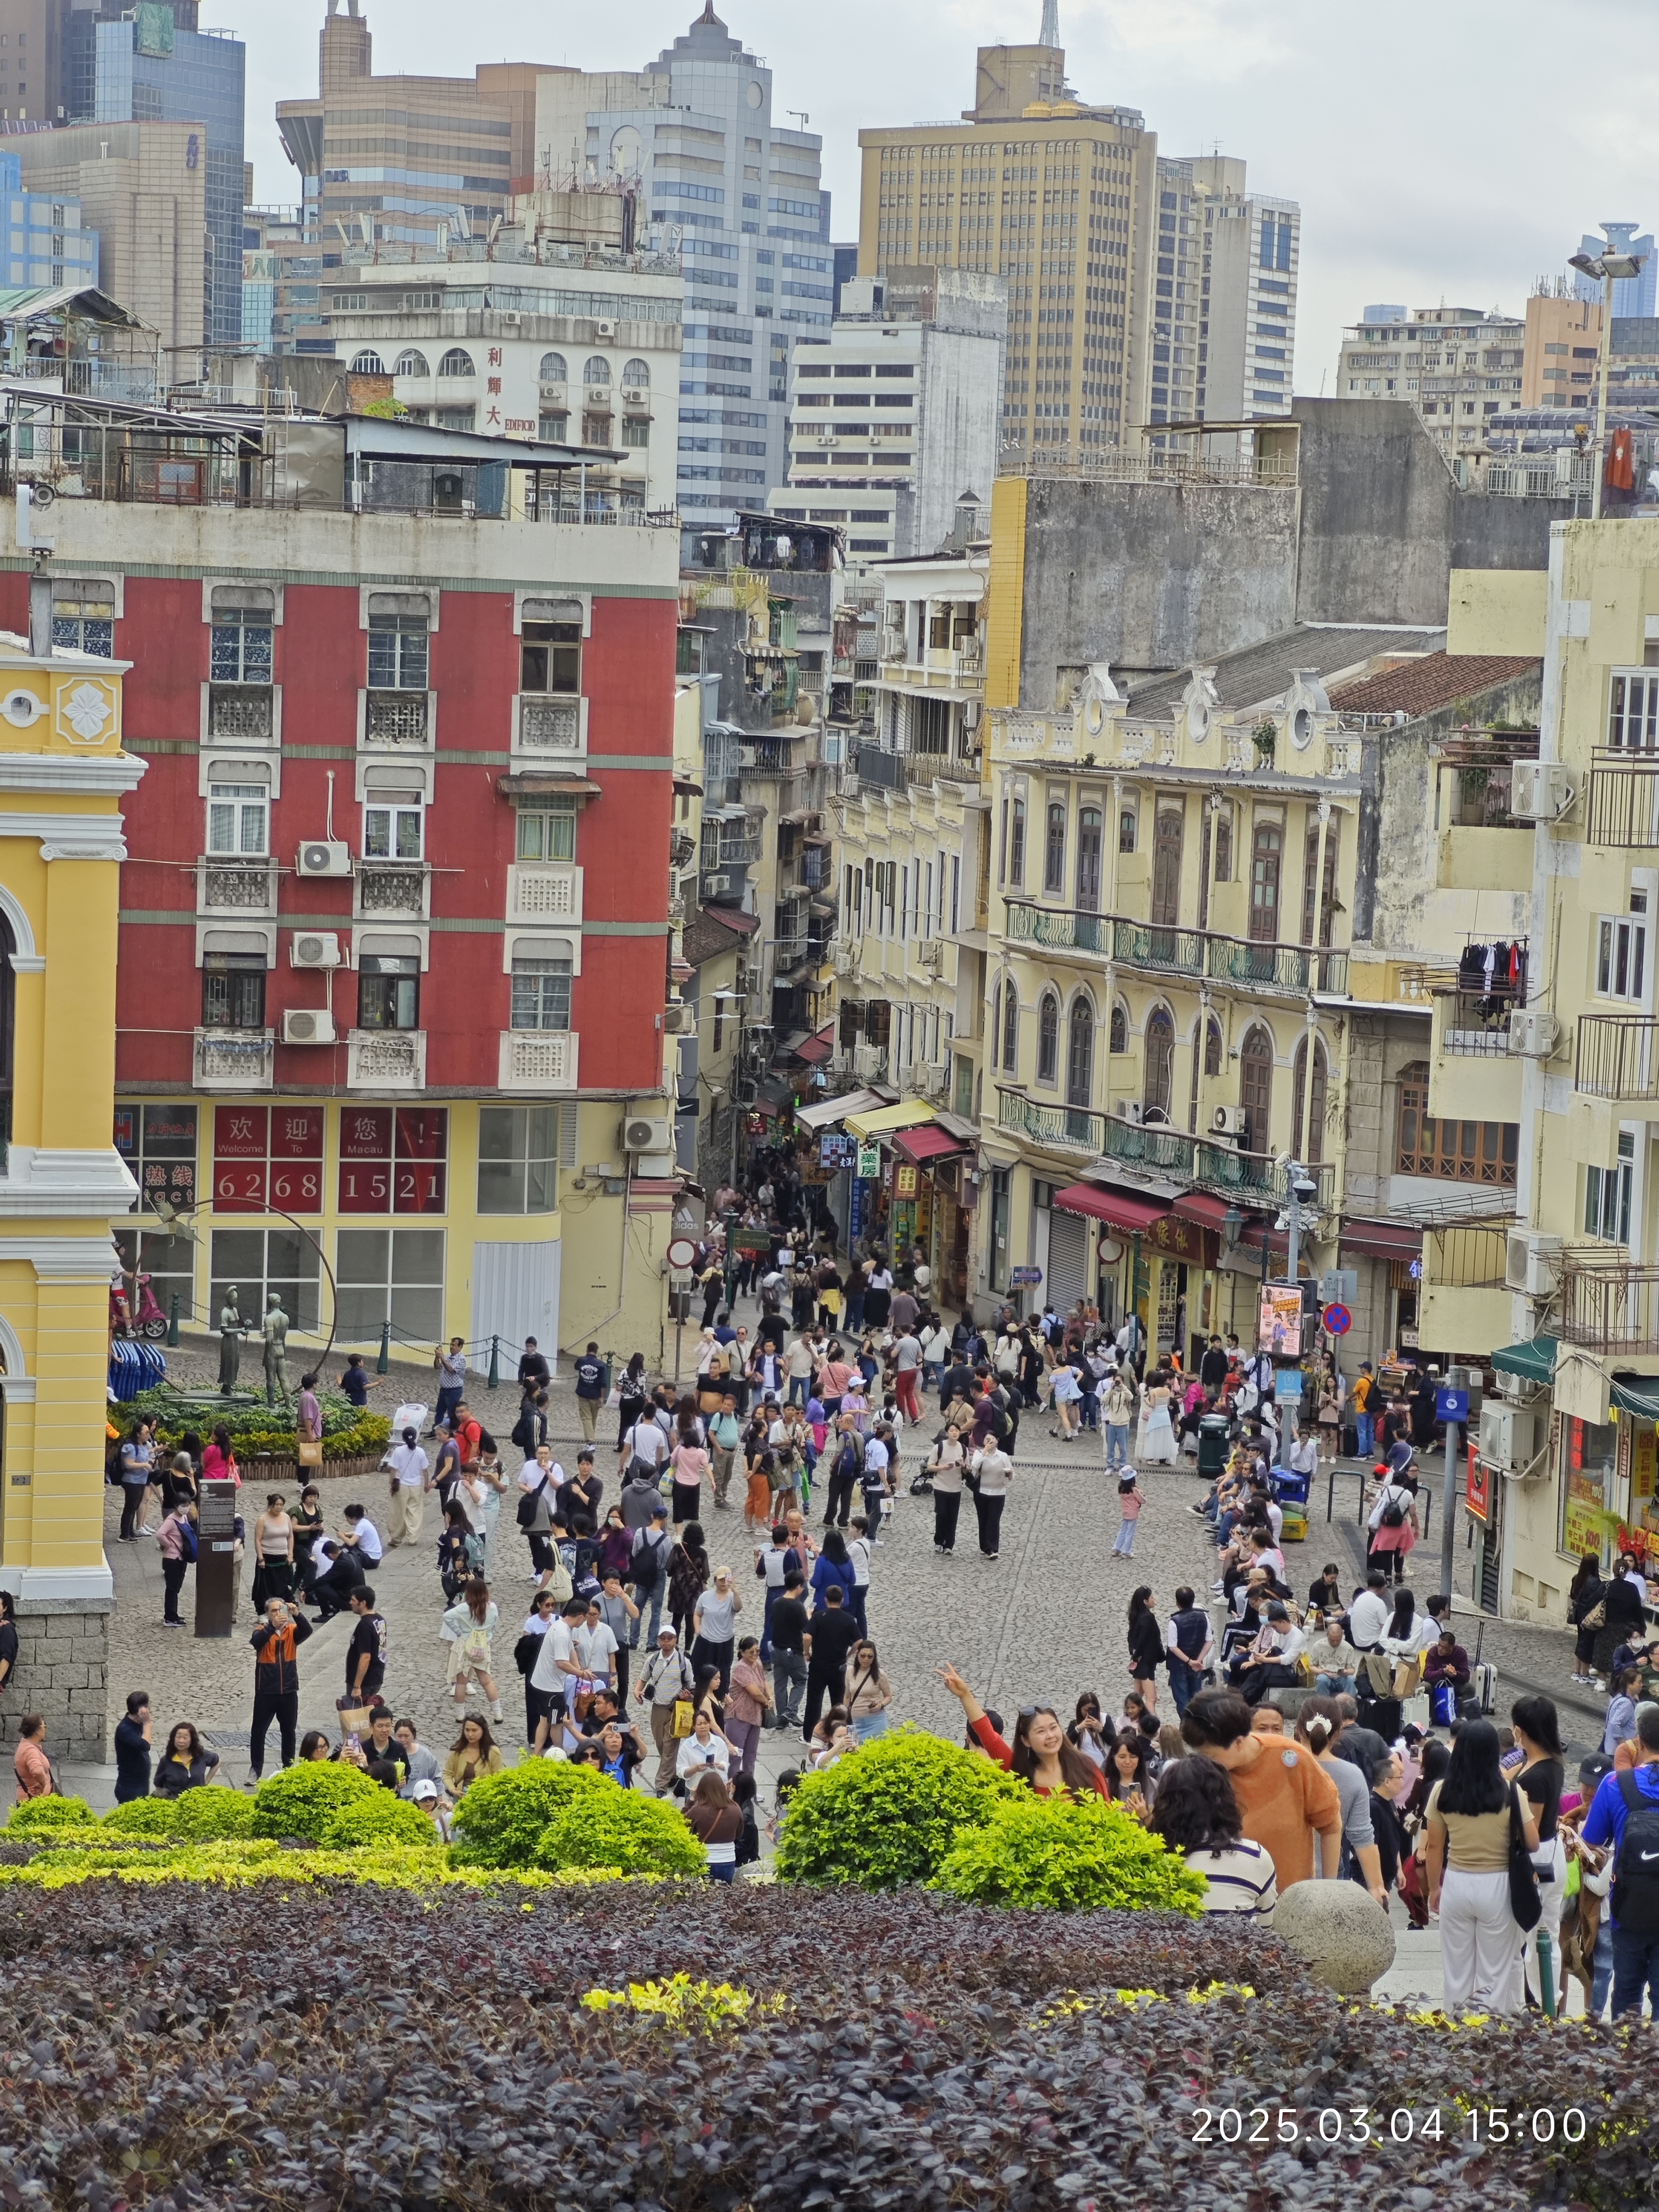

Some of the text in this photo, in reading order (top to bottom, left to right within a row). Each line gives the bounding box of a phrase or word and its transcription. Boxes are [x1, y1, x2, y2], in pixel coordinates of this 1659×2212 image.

[186, 133, 200, 169] BNU
[505, 419, 535, 431] EDIFICIO
[218, 1145, 383, 1154] Welcome To Macau
[130, 1165, 193, 1186] 热线
[219, 1174, 440, 1198] 6268 1521
[673, 1220, 699, 1230] didas
[1591, 1484, 1603, 1499] 100
[1585, 1529, 1600, 1549] 100
